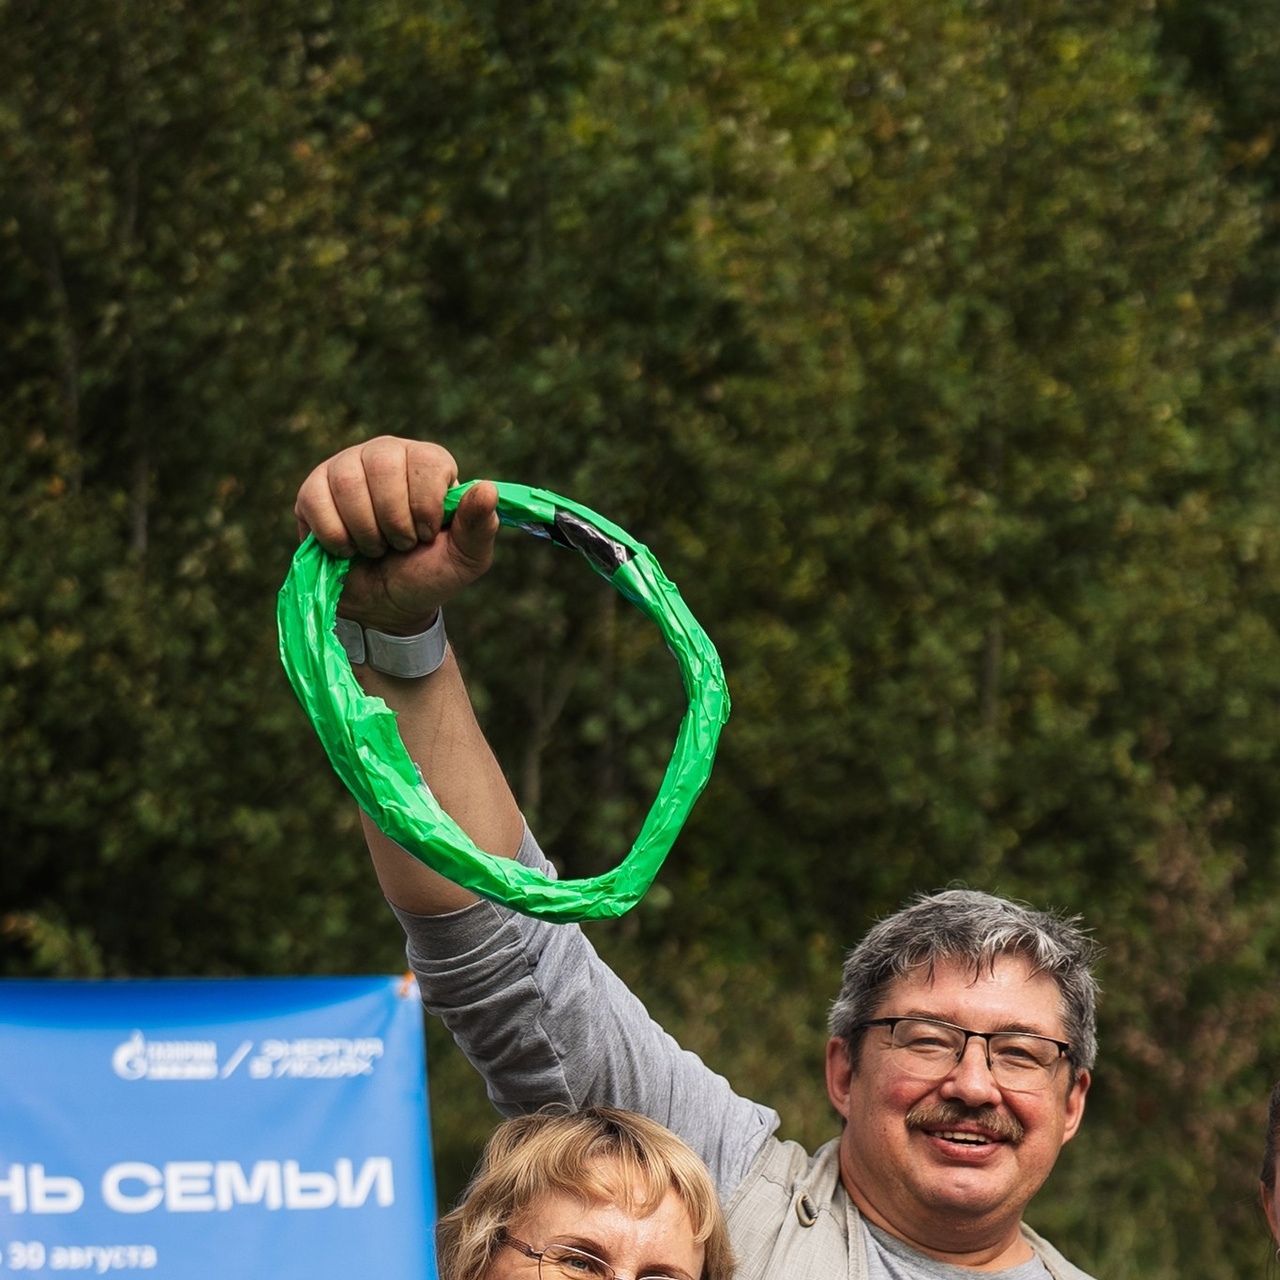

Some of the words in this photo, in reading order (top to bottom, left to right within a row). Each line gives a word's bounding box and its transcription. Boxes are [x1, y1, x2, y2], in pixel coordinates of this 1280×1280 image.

[102, 1156, 395, 1214] СЕМЬИ
[8, 1241, 46, 1270] 30
[50, 1244, 158, 1275] августа
